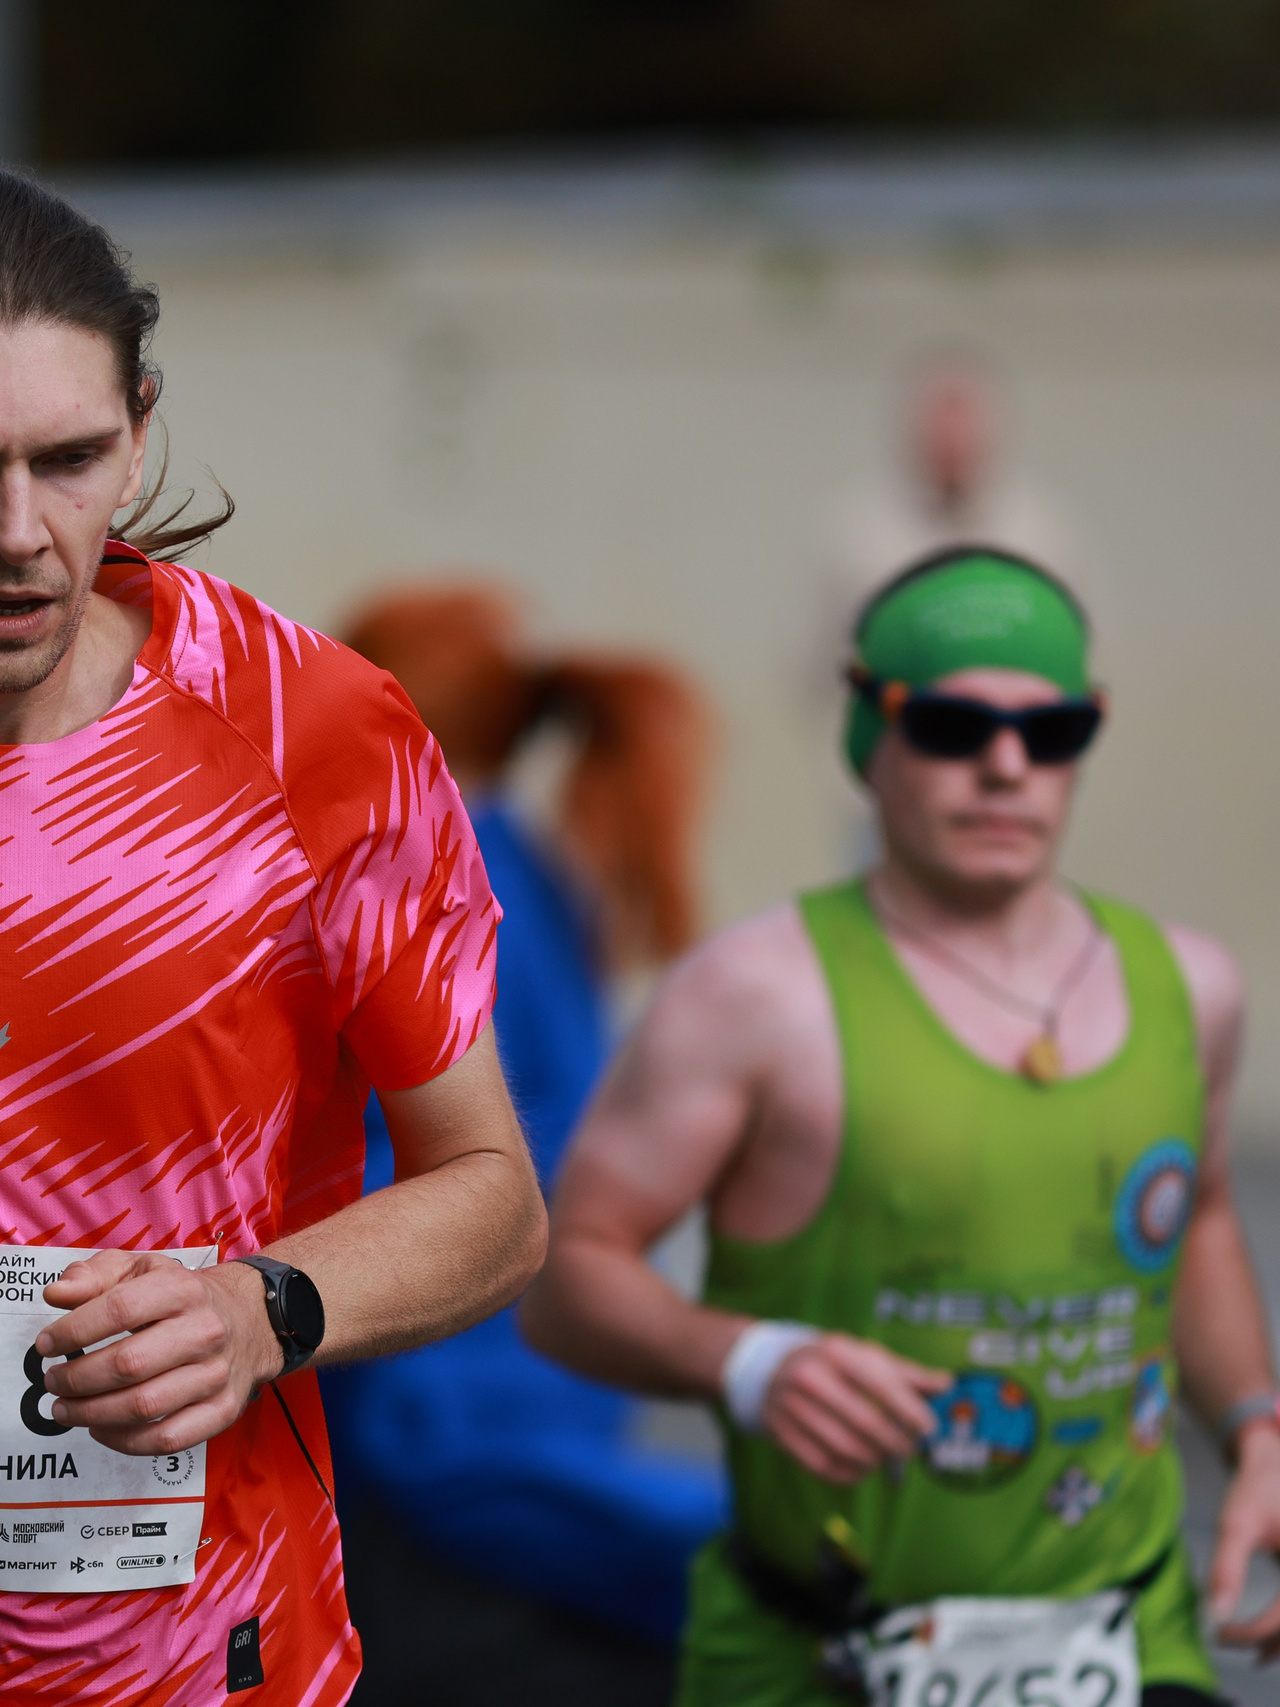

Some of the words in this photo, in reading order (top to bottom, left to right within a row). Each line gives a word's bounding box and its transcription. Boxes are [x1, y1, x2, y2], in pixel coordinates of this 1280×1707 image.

[166, 1455, 179, 1472] 3
[12, 1520, 65, 1534] МОСКОВСКИЙ
[97, 1526, 130, 1537] СБЕР
[135, 1525, 162, 1535] Прайм
[12, 1533, 38, 1544] СПОРТ
[87, 1560, 104, 1569] сбп
[120, 1557, 155, 1567] WINLINE
